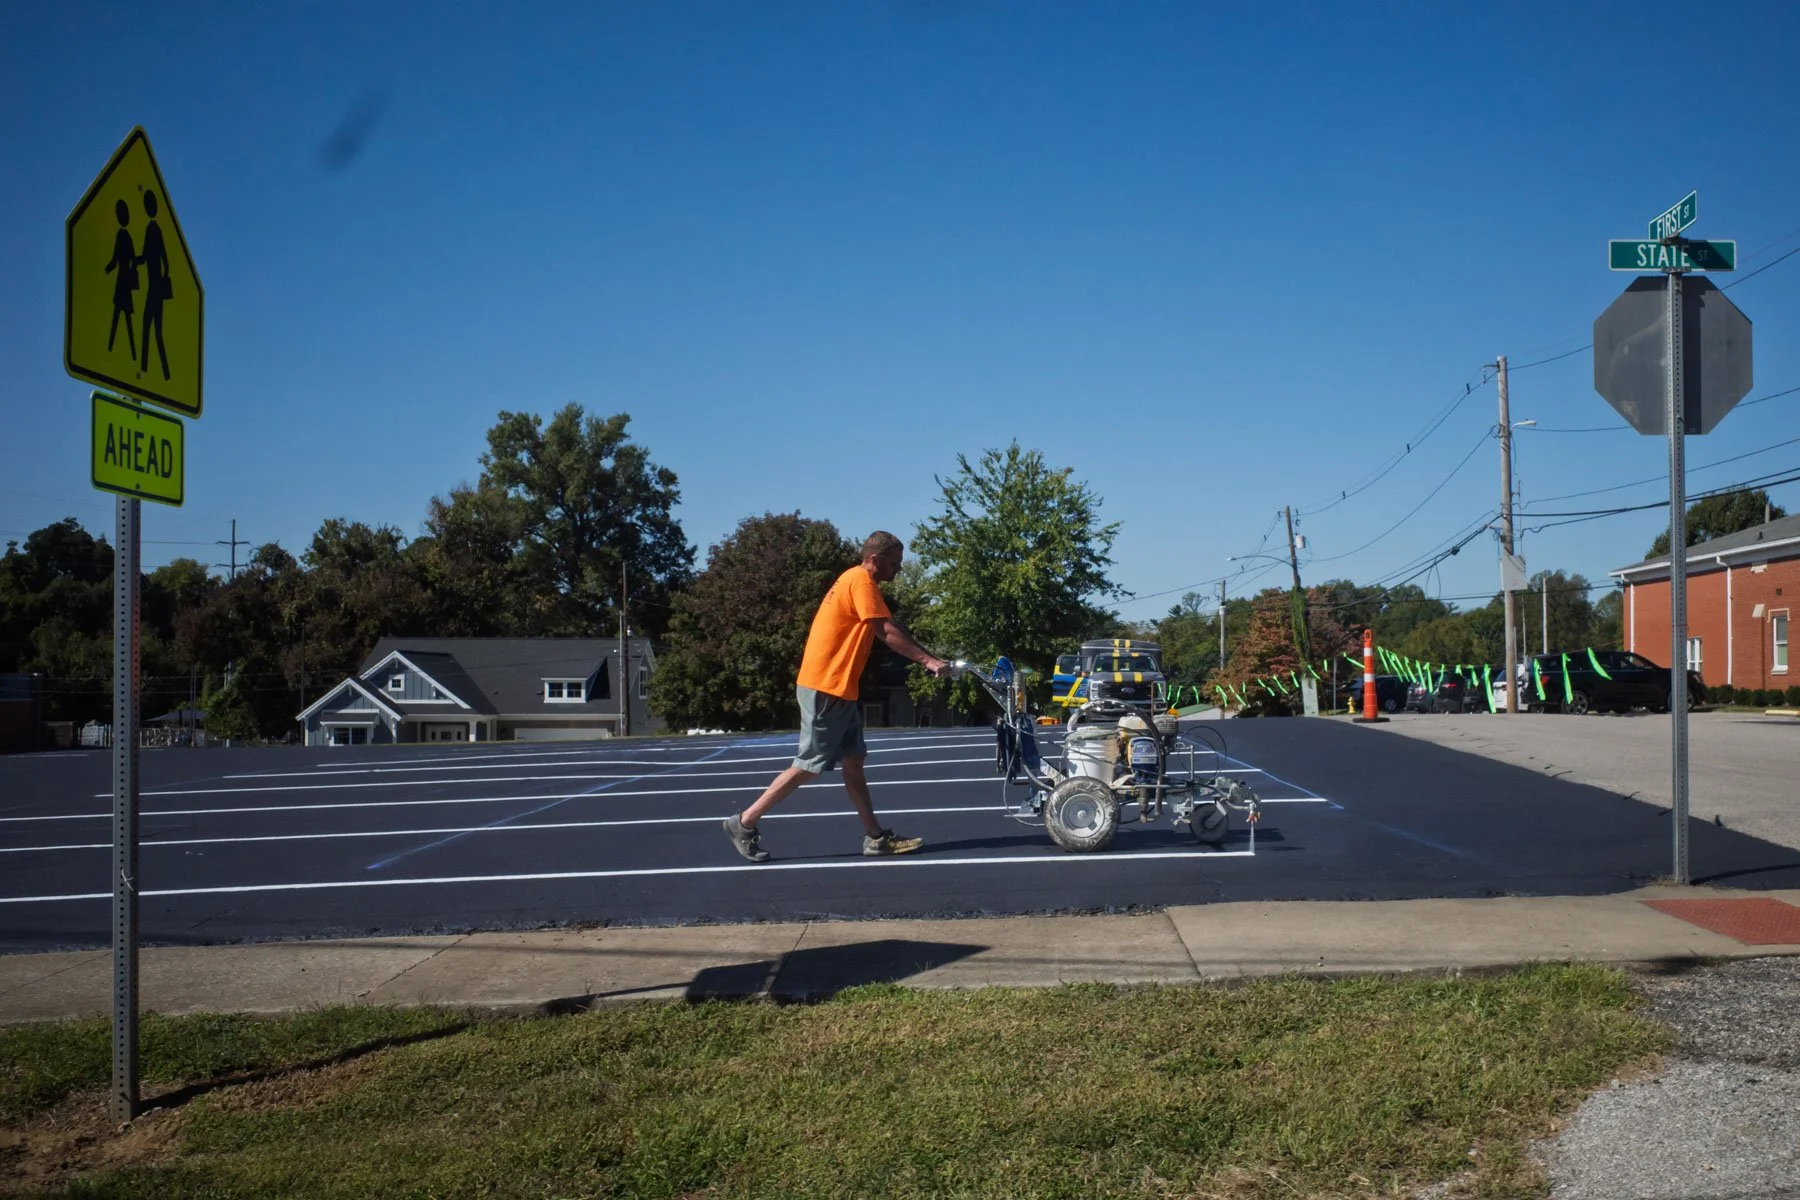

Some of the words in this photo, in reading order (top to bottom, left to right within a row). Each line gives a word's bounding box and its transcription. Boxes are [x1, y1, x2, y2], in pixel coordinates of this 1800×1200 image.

[1656, 205, 1682, 239] FIRST
[1683, 204, 1690, 219] ST
[1636, 244, 1690, 267] STATE
[104, 422, 173, 479] AHEAD
